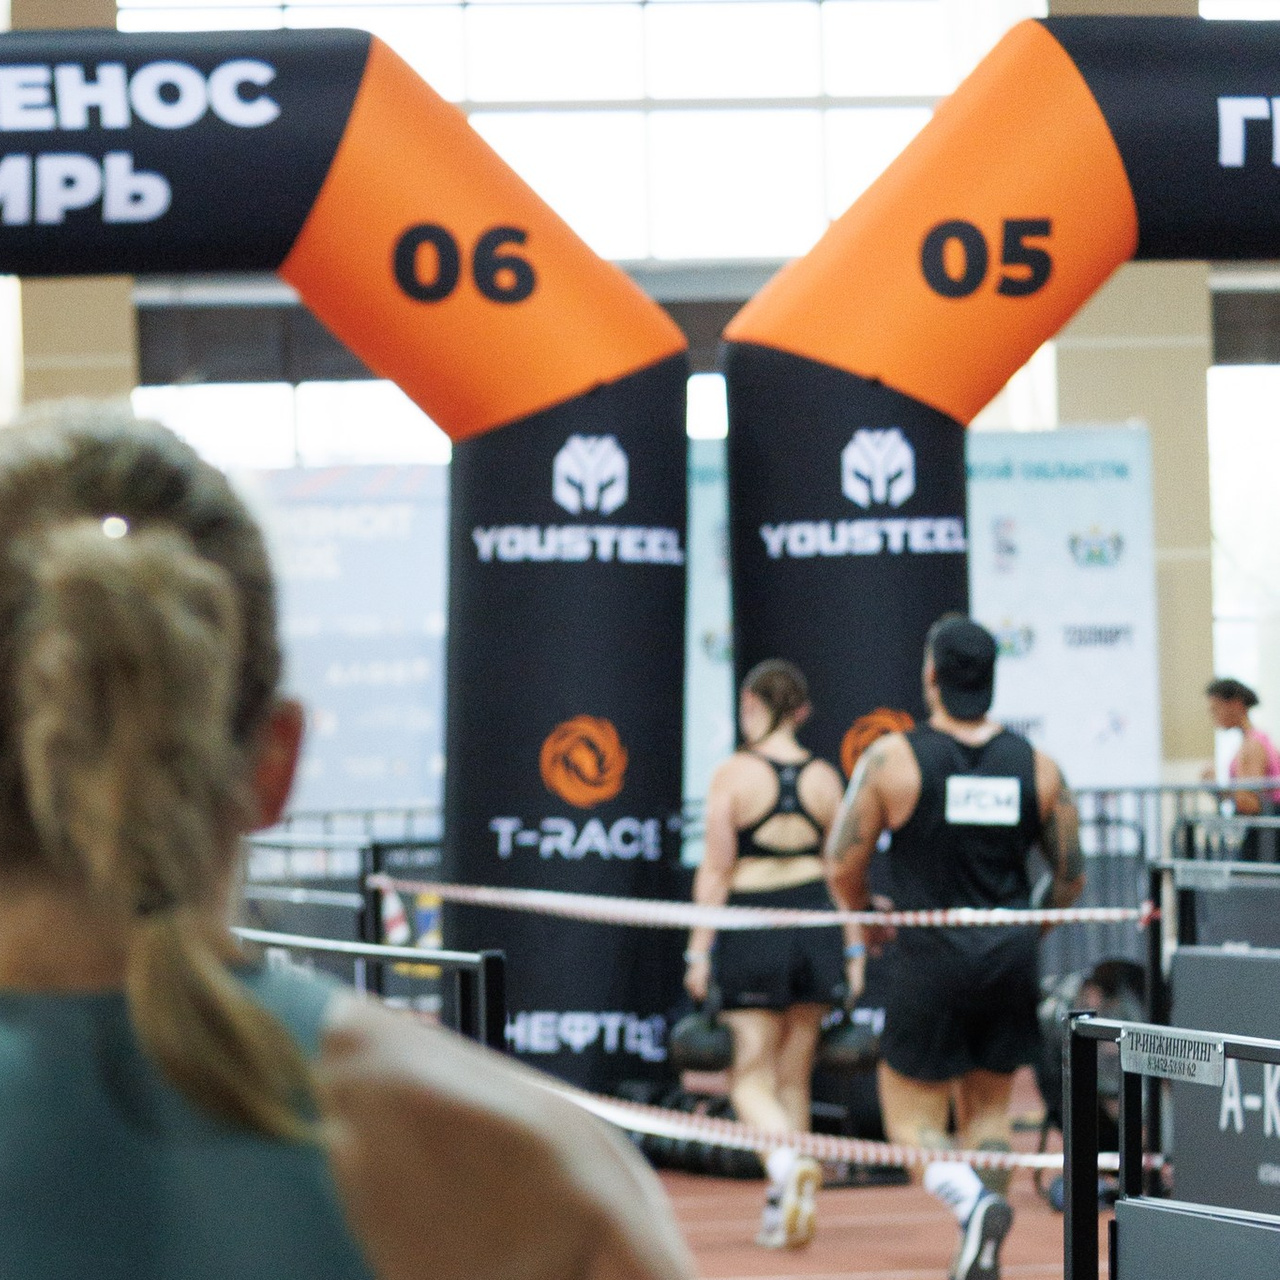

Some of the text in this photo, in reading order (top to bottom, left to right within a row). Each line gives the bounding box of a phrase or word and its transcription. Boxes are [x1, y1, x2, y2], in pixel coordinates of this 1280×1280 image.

[1217, 97, 1280, 168] Г
[393, 223, 537, 305] 06
[920, 218, 1055, 299] 05
[471, 525, 685, 566] YOUSTEEL
[760, 517, 966, 559] YOUSTEEL
